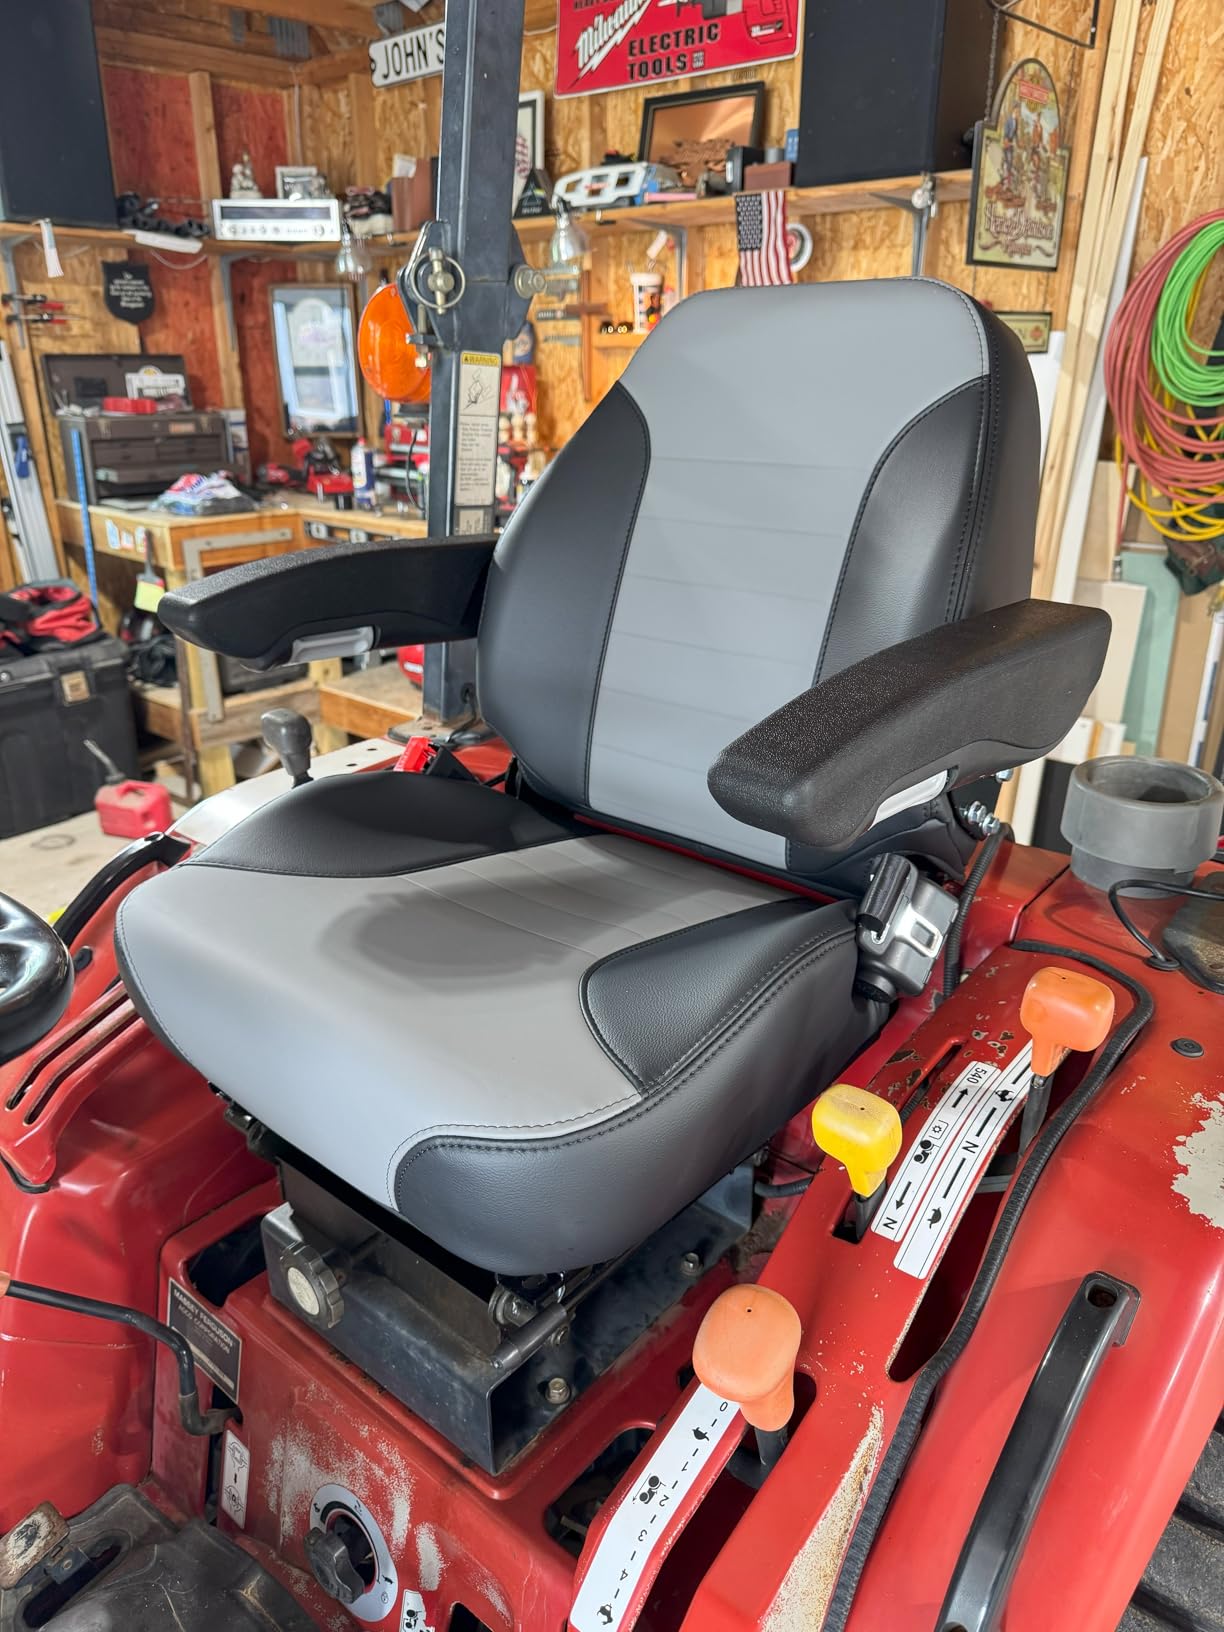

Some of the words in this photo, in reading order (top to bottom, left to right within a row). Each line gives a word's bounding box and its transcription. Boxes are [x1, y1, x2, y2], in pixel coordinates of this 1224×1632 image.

[628, 22, 719, 58] ELECTRIC
[382, 28, 445, 79] JOHN'S
[627, 53, 687, 81] TOOLS
[966, 1066, 987, 1084] 540
[962, 1140, 980, 1154] N
[882, 1217, 898, 1231] N
[681, 1461, 690, 1472] 1
[658, 1494, 670, 1507] 2
[637, 1529, 648, 1542] 3
[619, 1568, 629, 1581] 4
